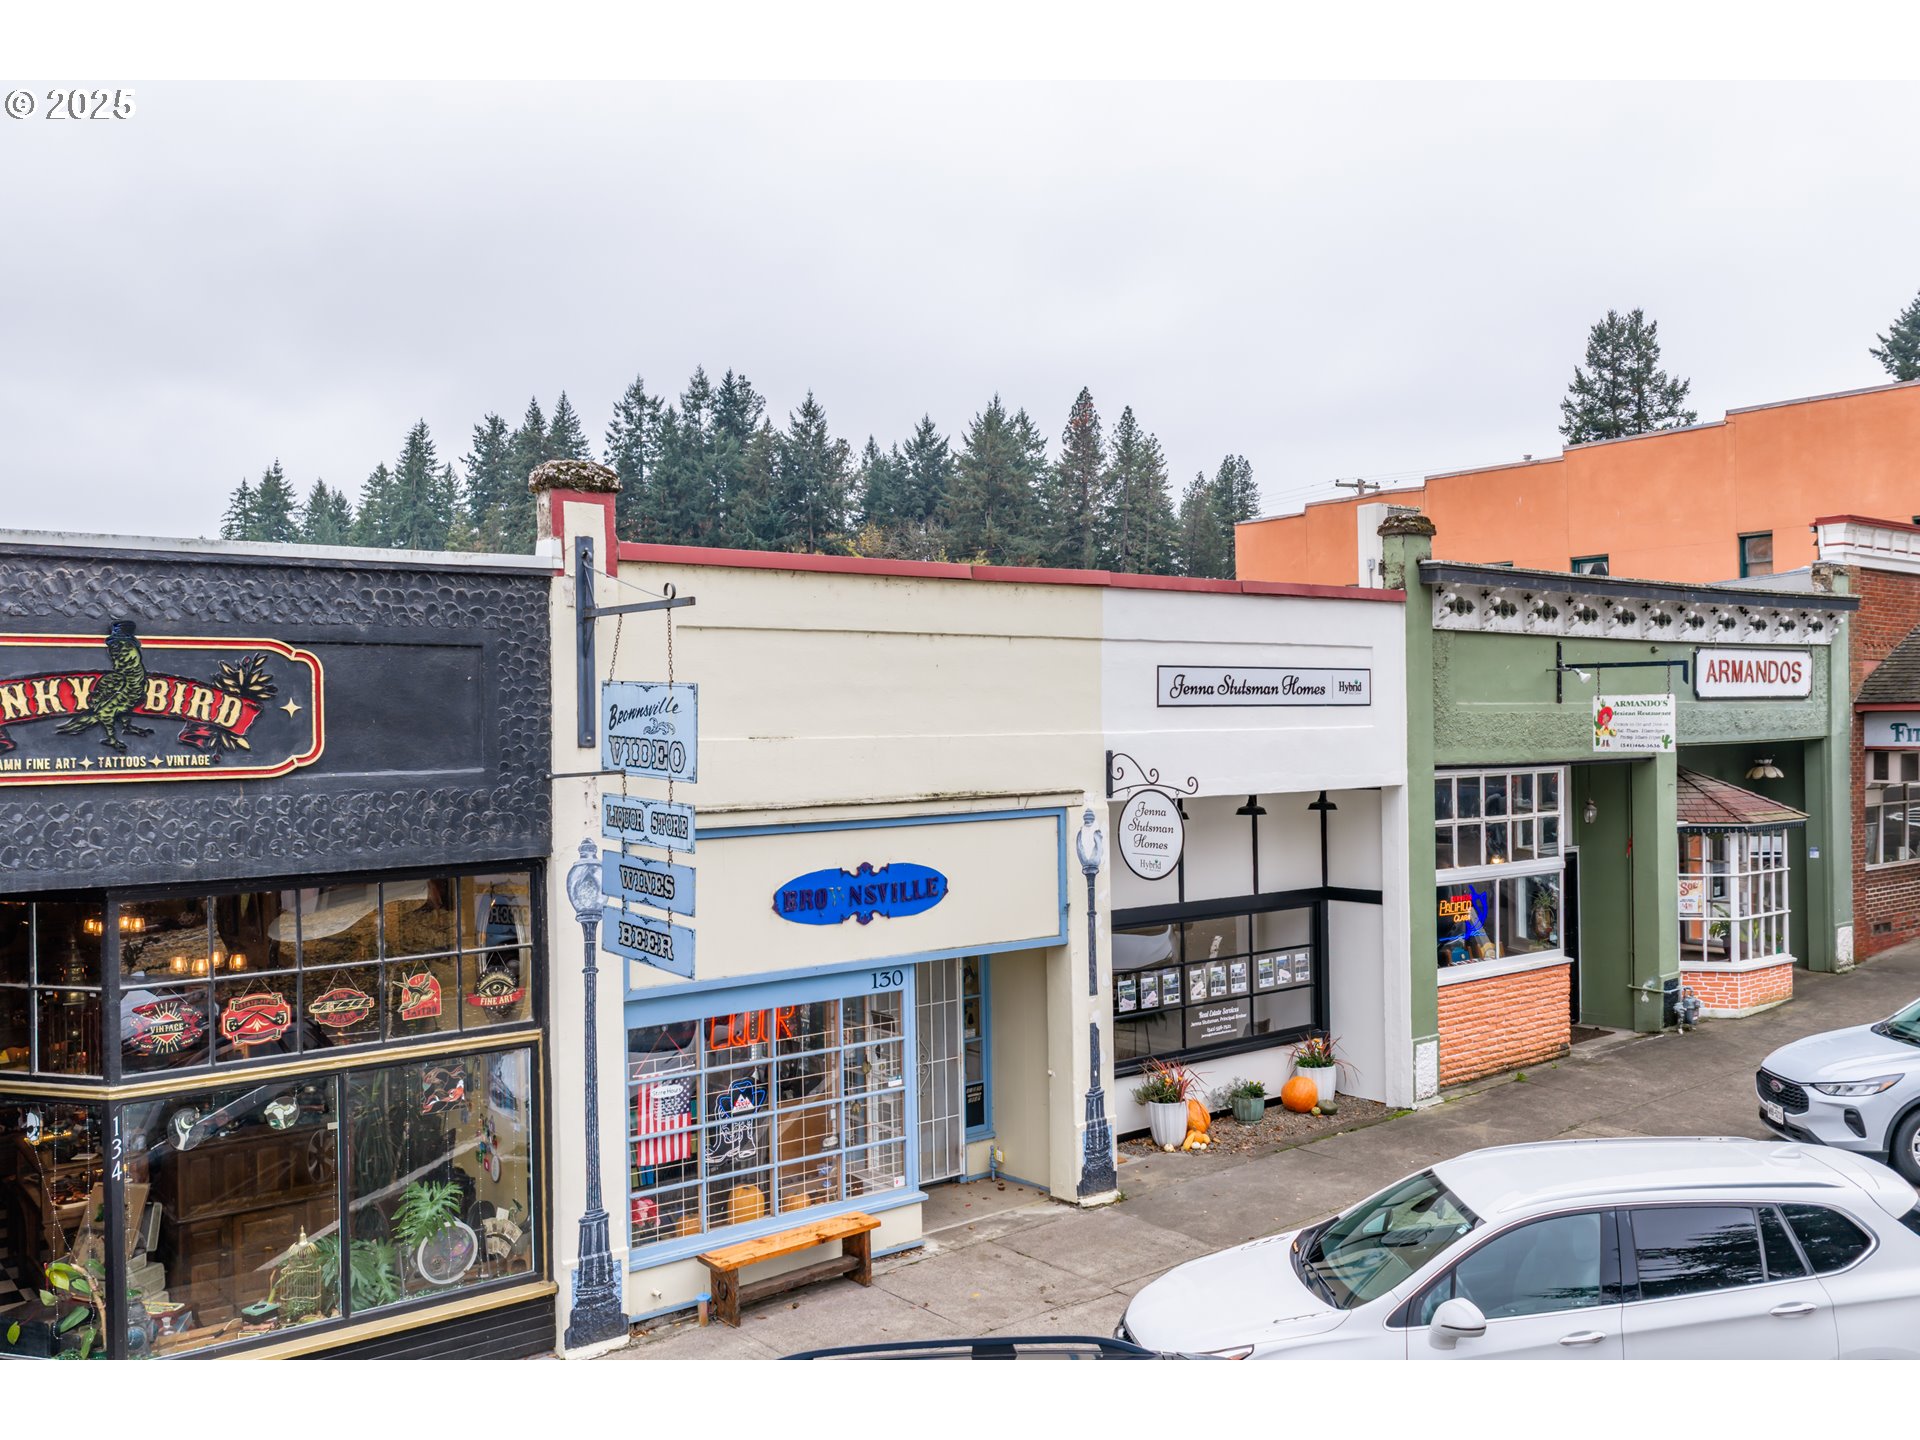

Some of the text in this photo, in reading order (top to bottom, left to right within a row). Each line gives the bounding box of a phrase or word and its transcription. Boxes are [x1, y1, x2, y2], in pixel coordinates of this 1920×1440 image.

[1706, 659, 1802, 685] ARMANDOS
[1169, 674, 1362, 698] Jenna Stutsman Homes Hybrid
[144, 678, 242, 728] BIRD
[608, 696, 683, 731] Brownsville
[26, 758, 51, 770] FINE
[55, 757, 77, 769] ART
[98, 756, 147, 768] TATTOOS
[166, 754, 211, 767] VINTAGE
[608, 735, 686, 774] VIDEO
[606, 804, 688, 839] LIQUOR STORE
[1135, 801, 1167, 818] Jenna
[1128, 817, 1174, 834] Stutsman
[1133, 833, 1168, 850] Homes
[1140, 859, 1162, 871] Hybrid
[619, 864, 675, 900] WINES
[782, 876, 939, 913] BRONSVILLE
[619, 920, 674, 961] BEER
[871, 969, 904, 989] 130
[480, 994, 513, 1006] FINE ART
[150, 1023, 184, 1034] VINTAGE
[652, 1086, 682, 1097] Store Hours
[111, 1115, 123, 1181] 134
